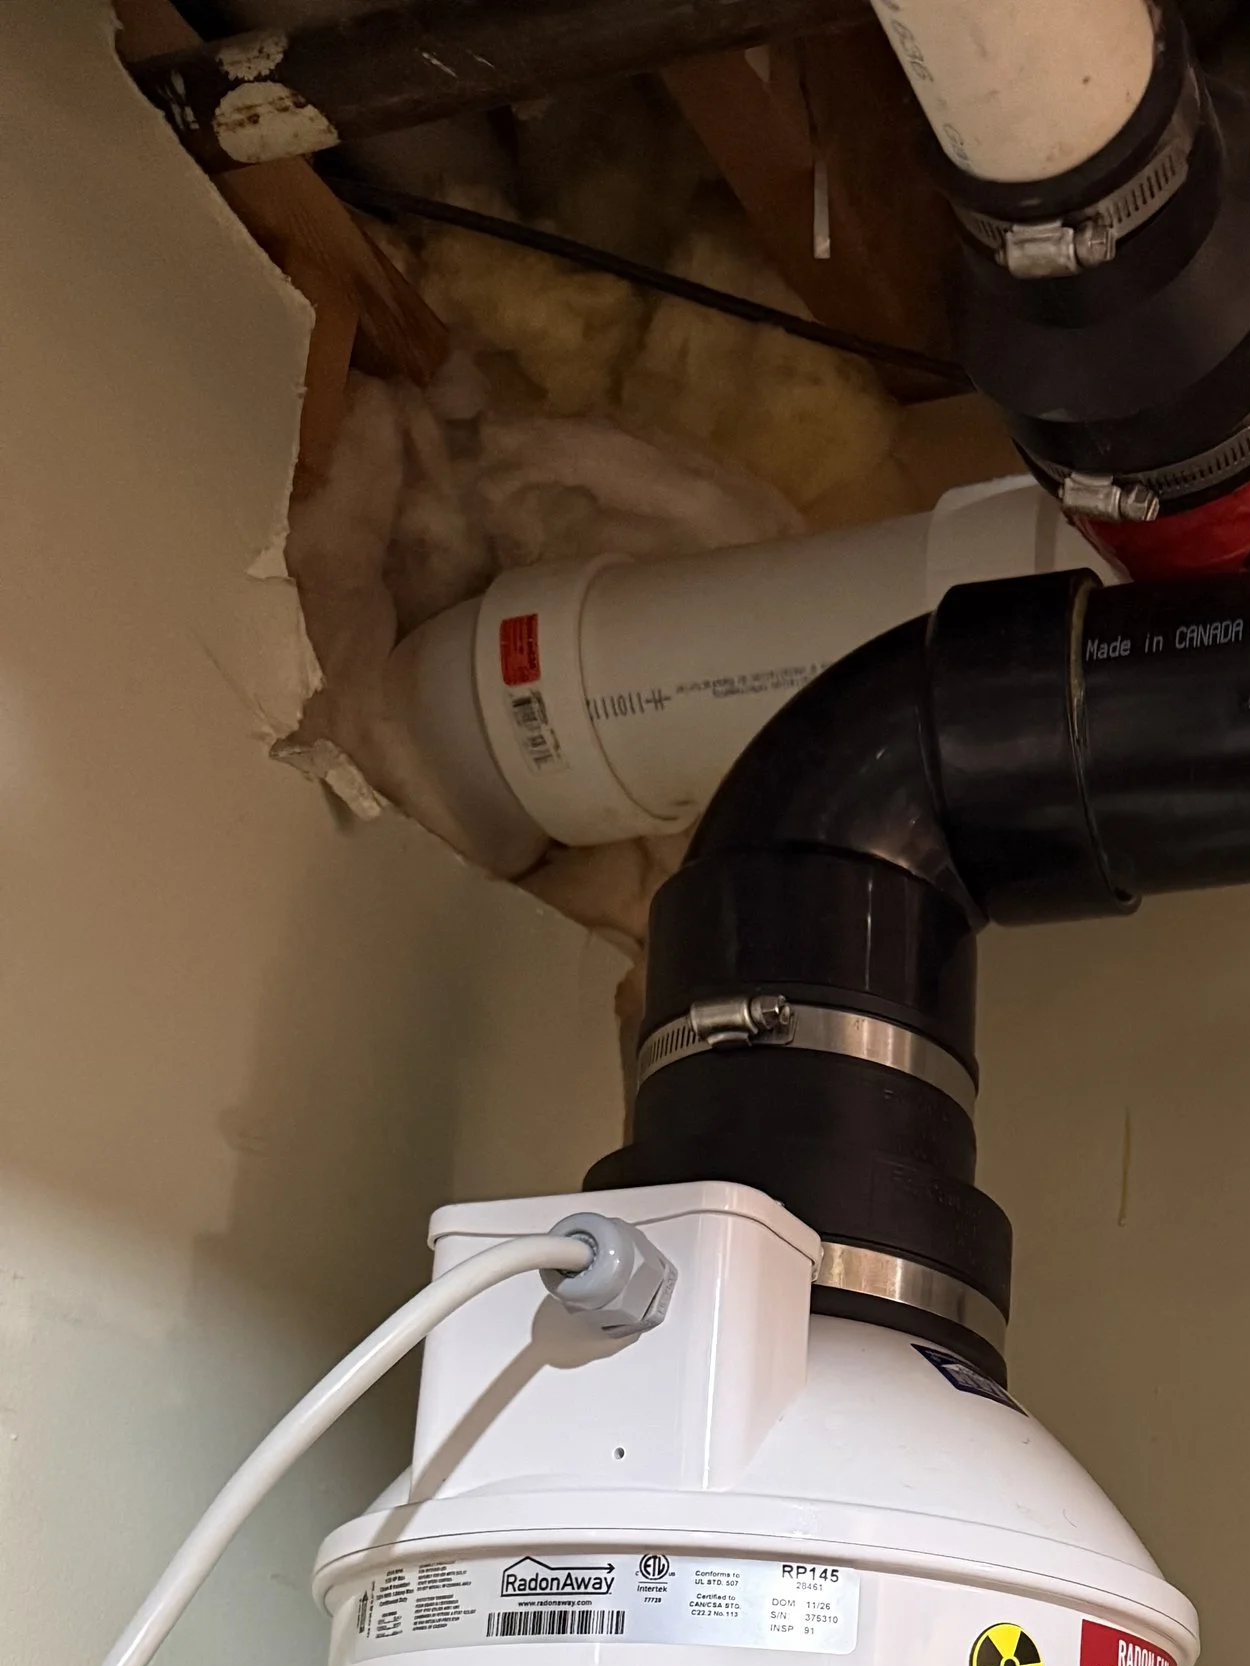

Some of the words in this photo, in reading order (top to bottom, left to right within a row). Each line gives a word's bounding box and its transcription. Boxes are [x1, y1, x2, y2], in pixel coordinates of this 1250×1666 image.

[1086, 638, 1131, 661] Made
[1144, 632, 1164, 652] in
[1175, 618, 1242, 650] CANADA
[695, 1570, 731, 1578] Conforms
[782, 1564, 839, 1583] RP145
[505, 1571, 615, 1594] RadonAway
[796, 1581, 823, 1591] 28461
[637, 1585, 668, 1593] Intertek
[696, 1593, 727, 1601] Certified
[518, 1599, 592, 1608] www.radonaway.com
[771, 1598, 796, 1607] DOM
[806, 1601, 831, 1611] 11/26
[805, 1613, 839, 1624] 375310
[770, 1624, 794, 1633] INSP
[804, 1626, 815, 1635] 91
